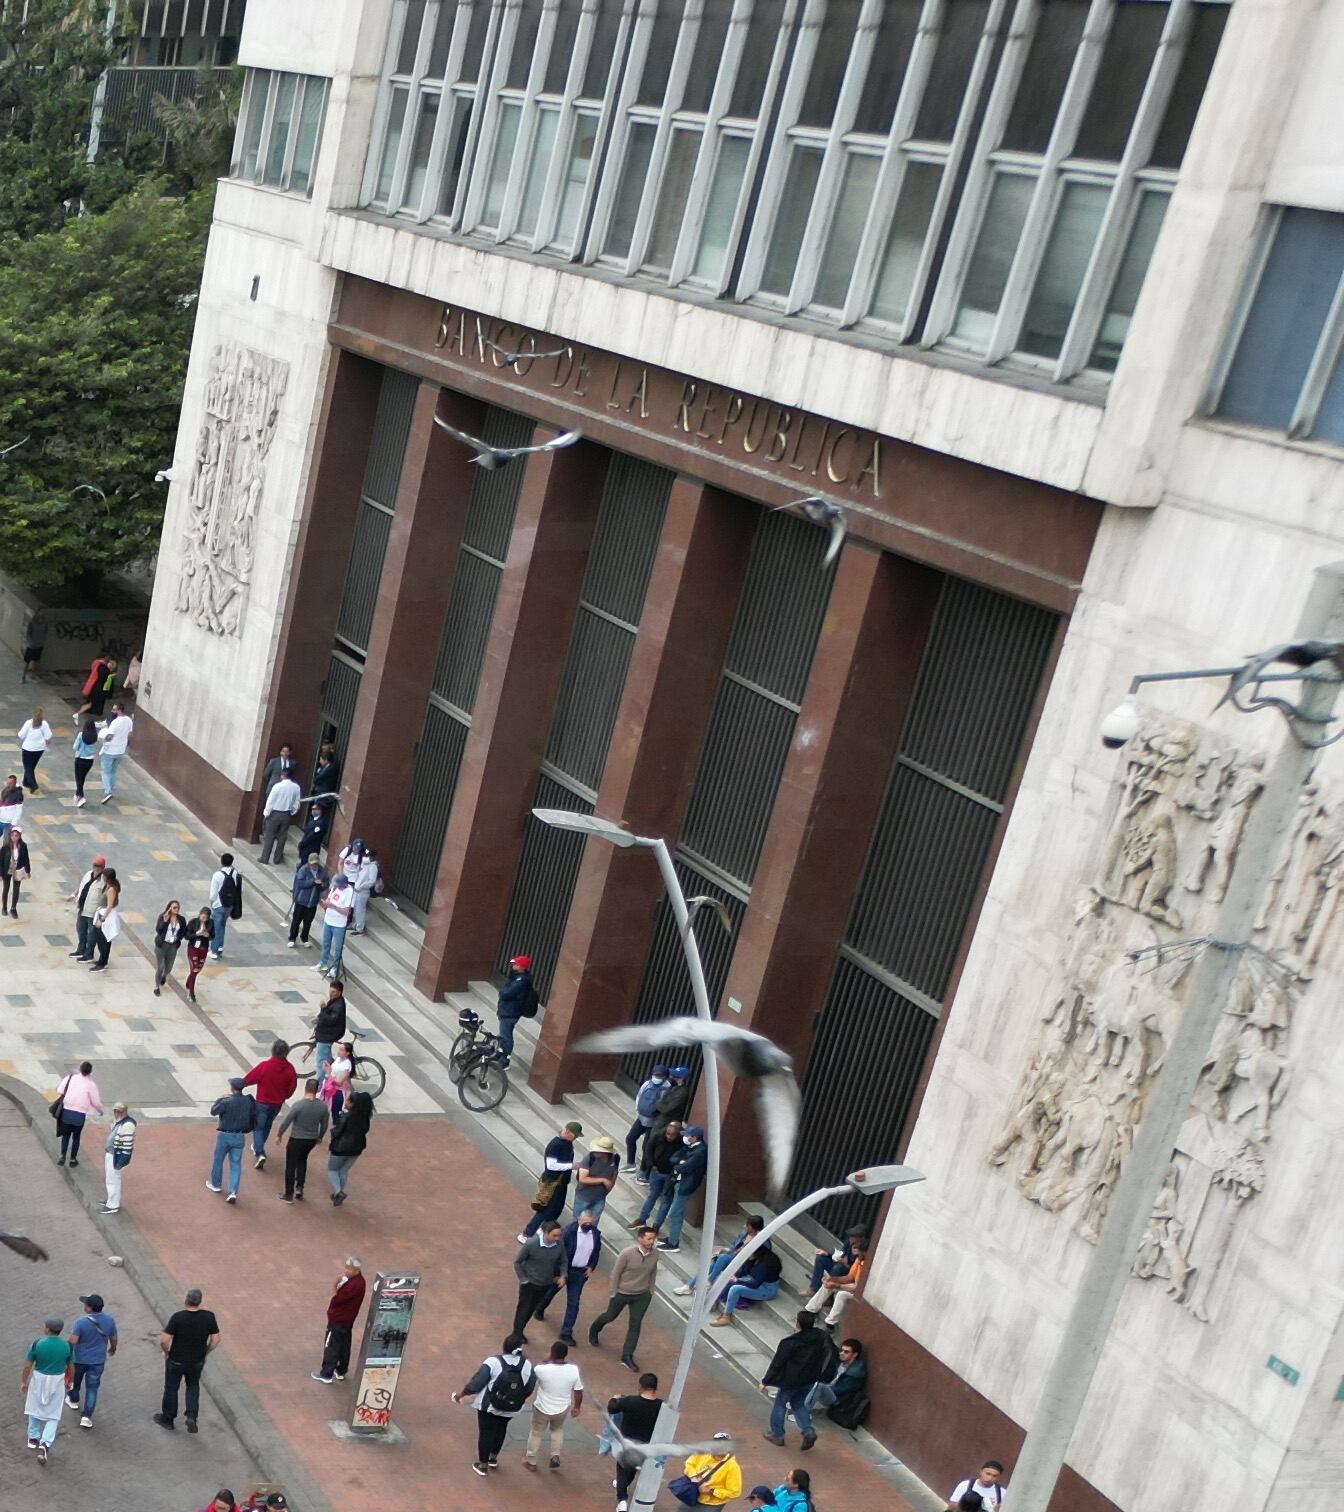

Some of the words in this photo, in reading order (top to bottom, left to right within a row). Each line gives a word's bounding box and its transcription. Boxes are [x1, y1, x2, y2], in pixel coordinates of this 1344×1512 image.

[435, 306, 536, 377] BANCO
[551, 346, 591, 398] DE
[606, 359, 649, 418] LA
